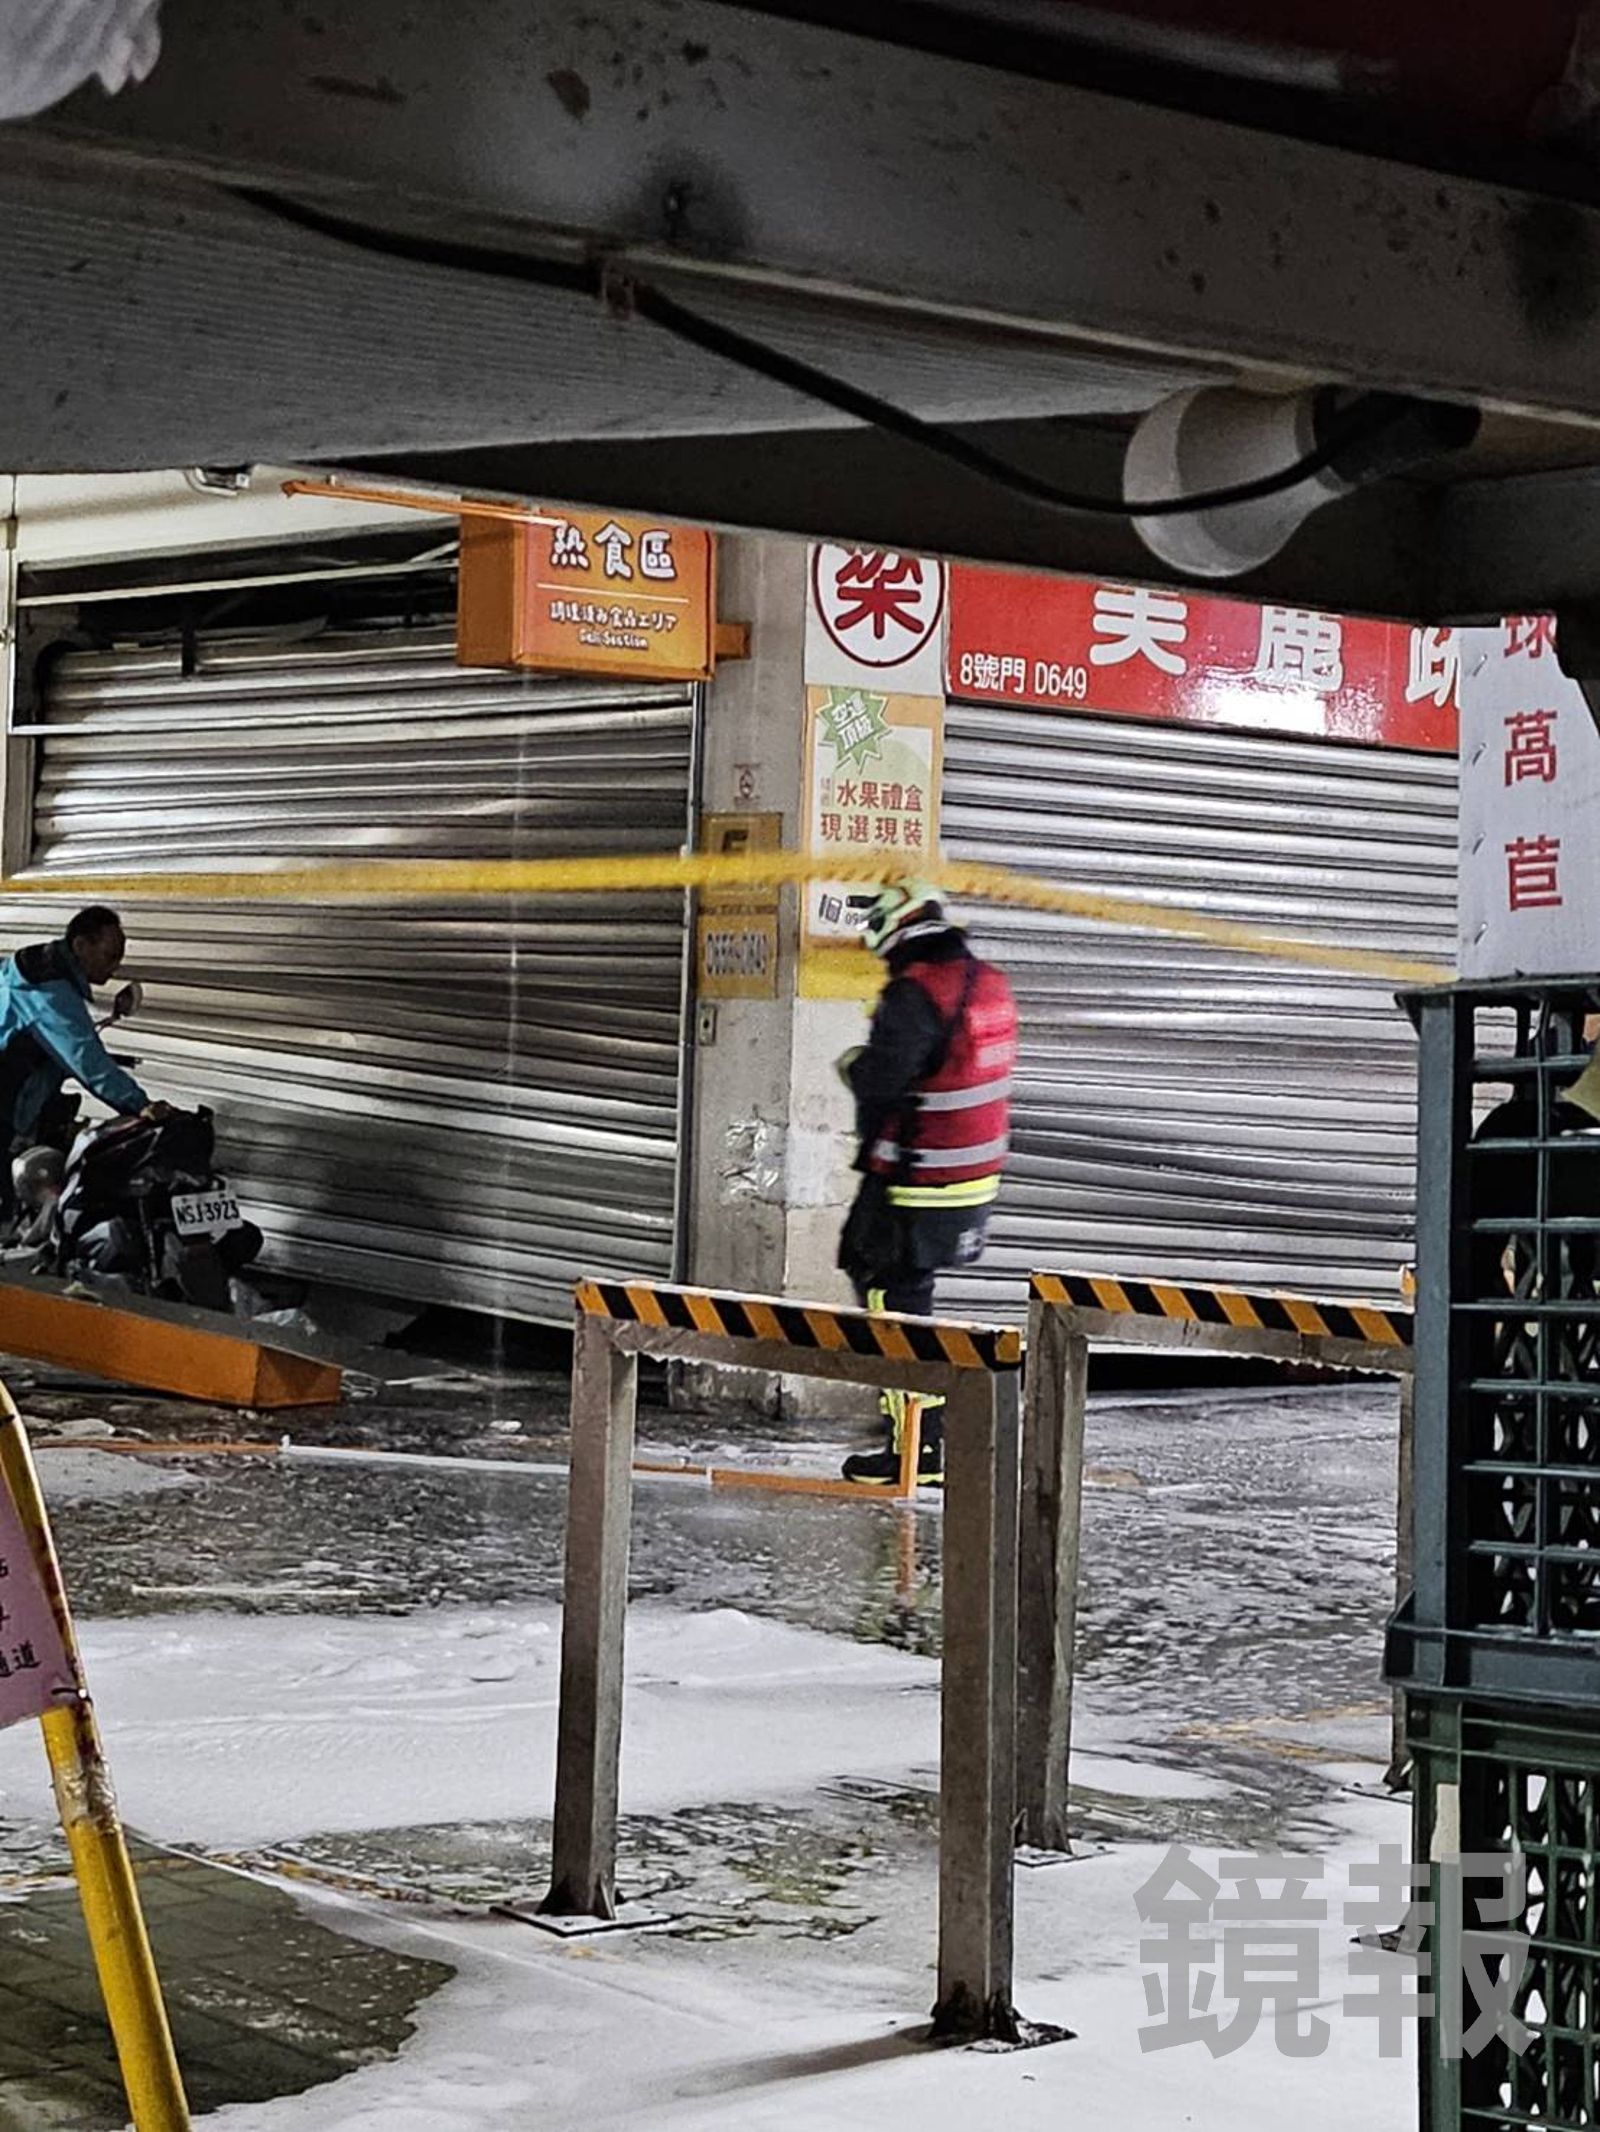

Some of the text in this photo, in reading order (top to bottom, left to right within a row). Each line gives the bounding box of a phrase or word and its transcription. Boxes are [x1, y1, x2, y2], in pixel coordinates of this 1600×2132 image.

[550, 520, 676, 579] 熱食區
[960, 652, 1088, 700] 8號門 D649
[836, 778, 923, 812] 水果禮盒
[820, 812, 922, 847] 現選現裝
